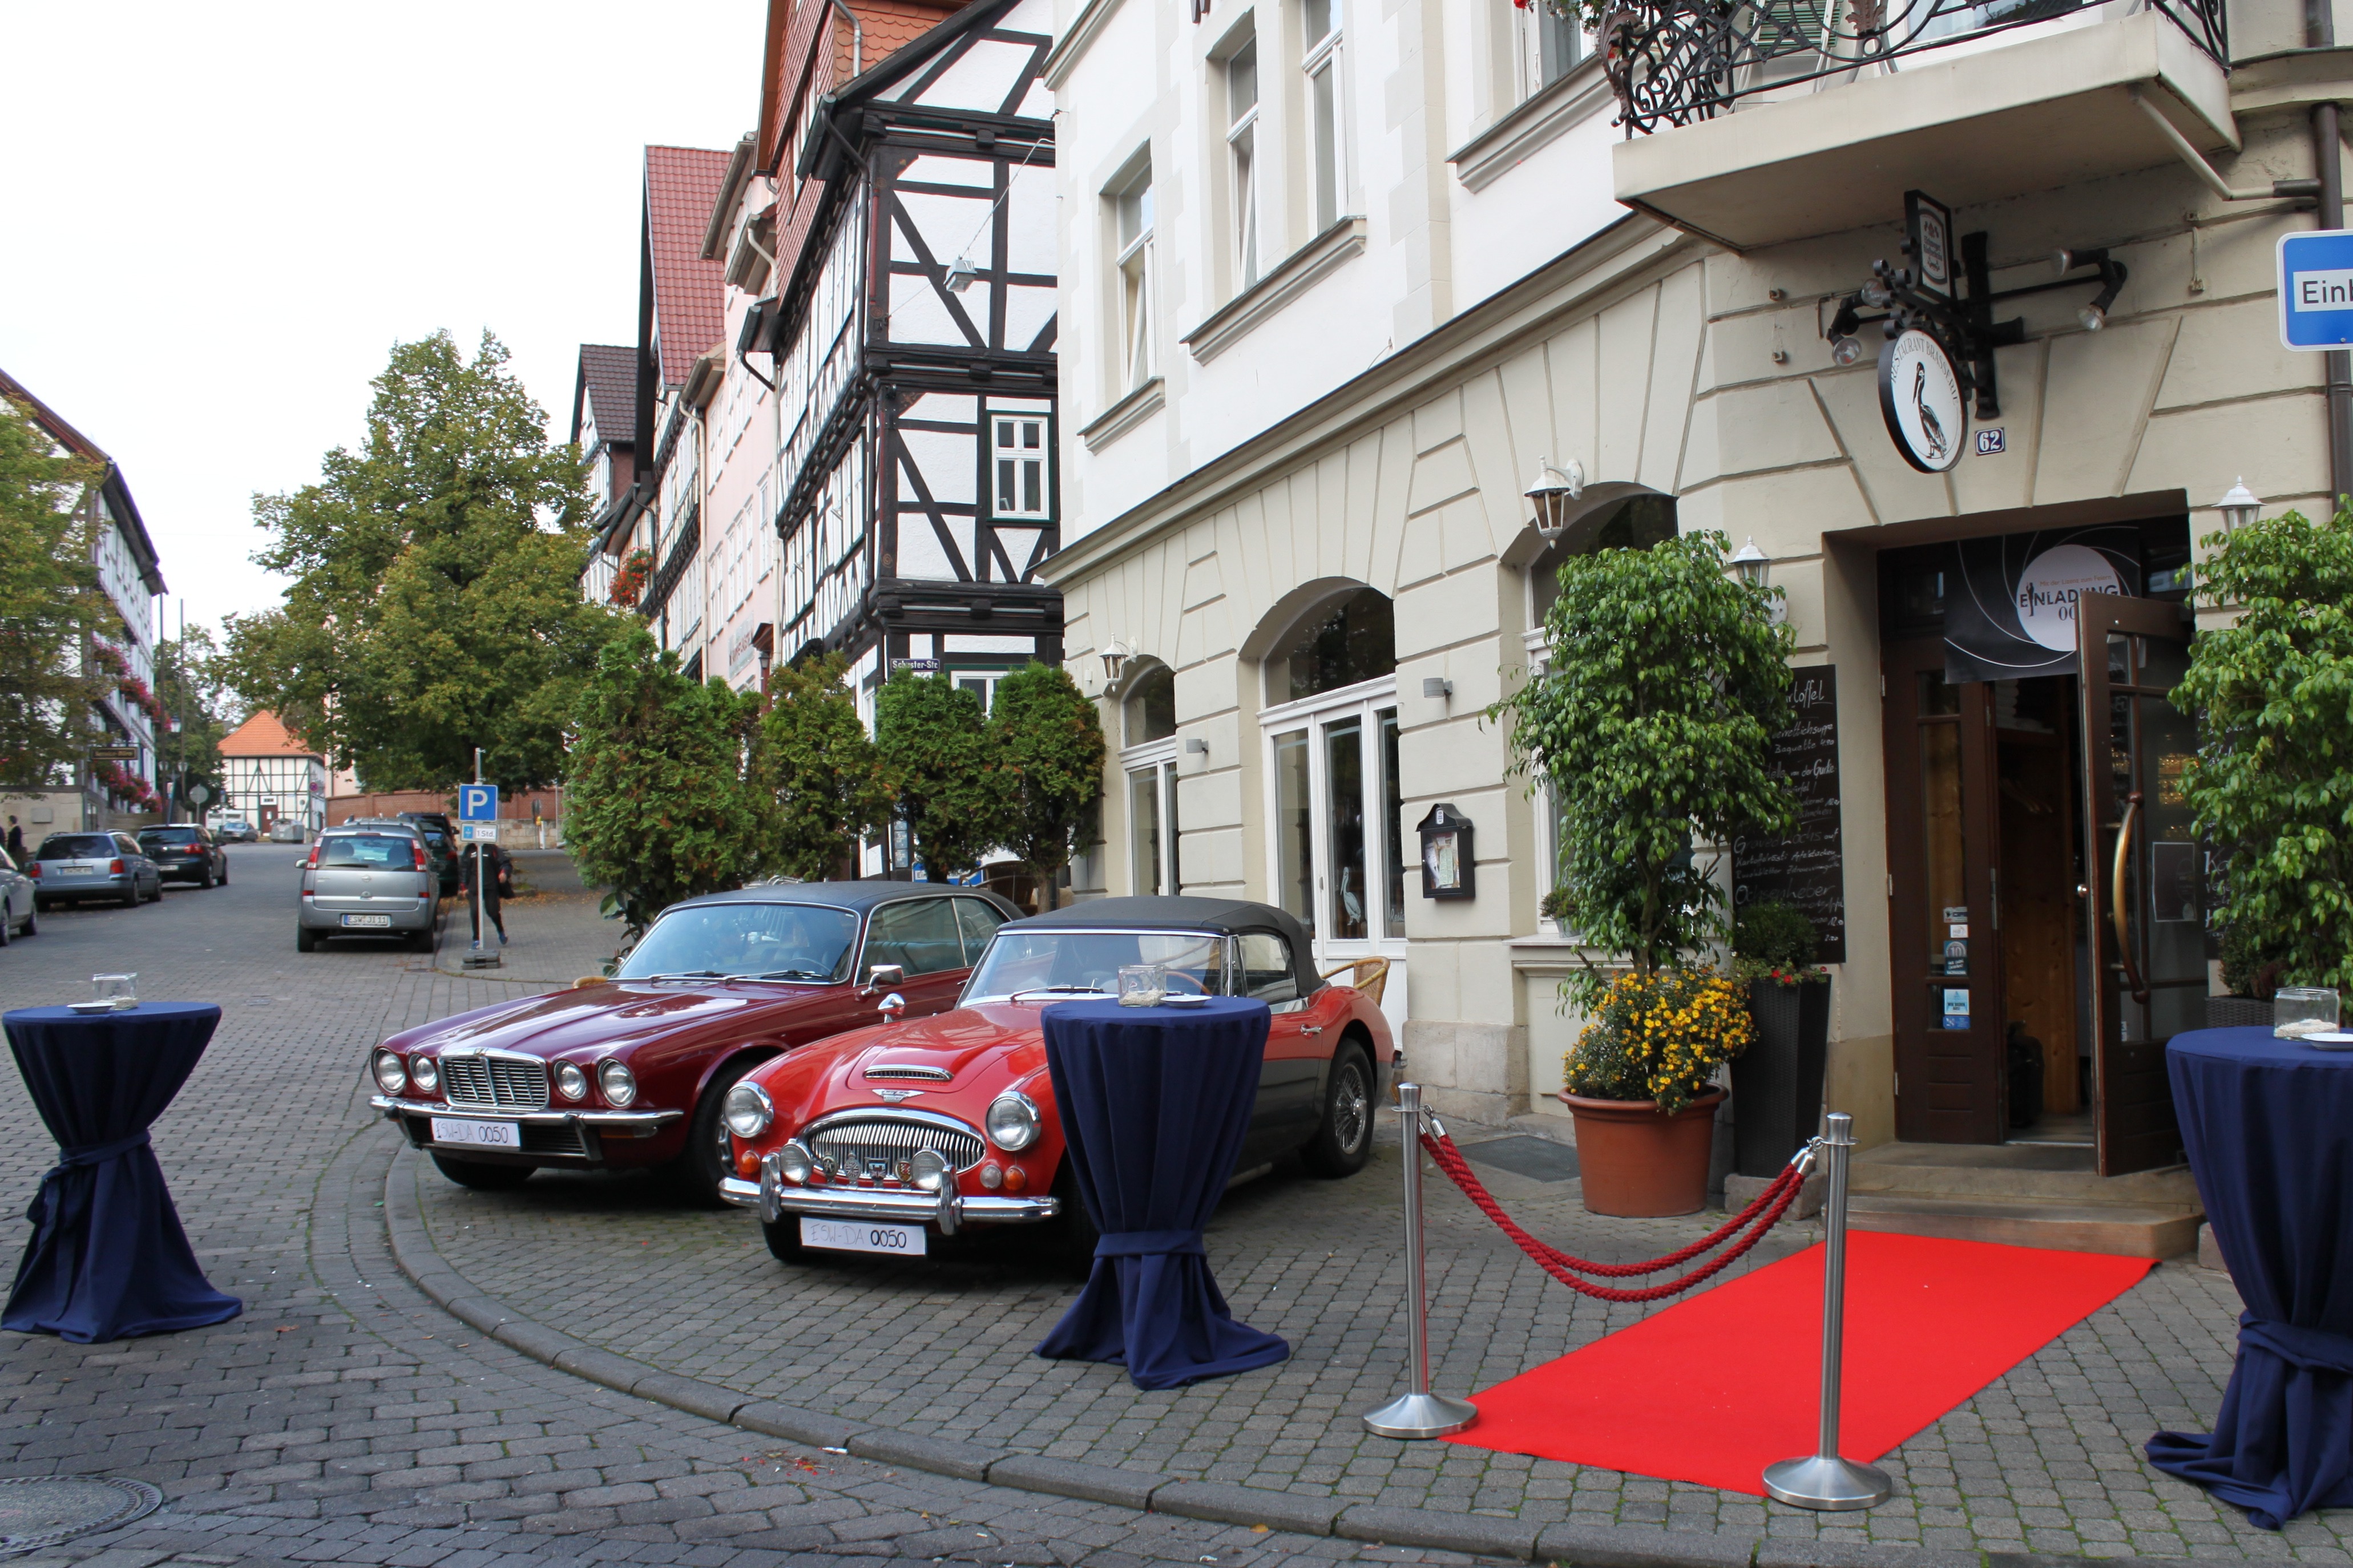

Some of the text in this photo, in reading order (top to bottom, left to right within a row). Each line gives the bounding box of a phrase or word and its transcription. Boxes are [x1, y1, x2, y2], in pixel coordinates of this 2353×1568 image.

[1891, 337, 1959, 406] RESTAURANT BRASSERIE
[1979, 430, 2000, 452] 62
[2020, 585, 2118, 608] EINLADG
[2058, 606, 2075, 621] 00
[1786, 680, 1825, 708] rtoffel
[1813, 759, 1835, 780] Gurke
[468, 789, 488, 817] P
[435, 1121, 508, 1143] ESW-DA 0050
[810, 1223, 907, 1248] ESW-DA 0050
